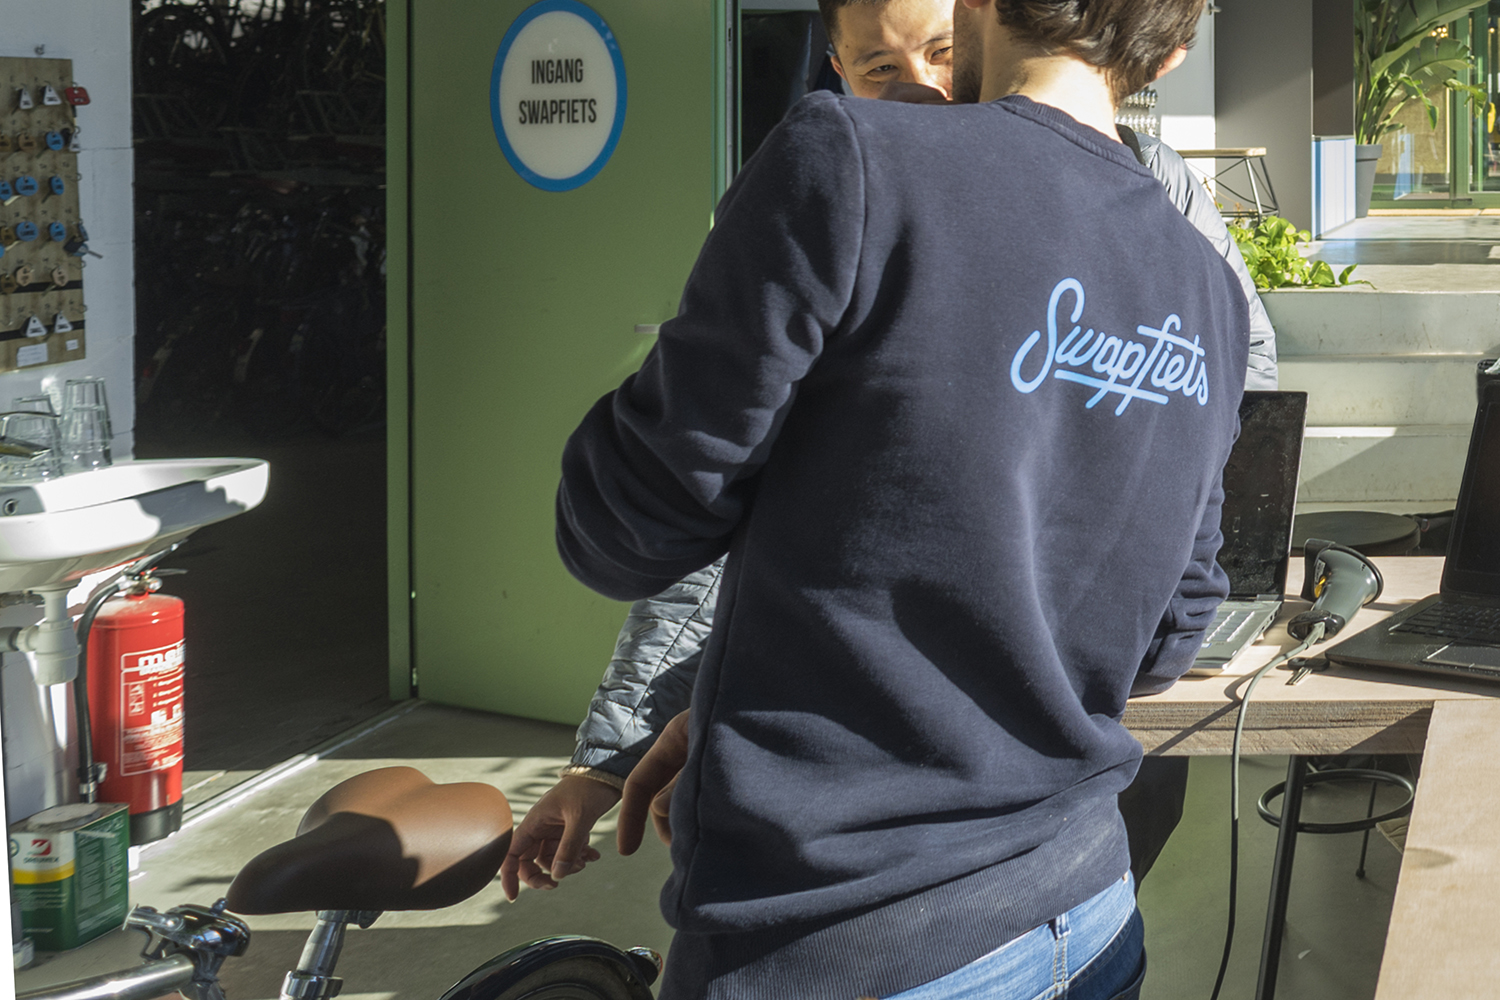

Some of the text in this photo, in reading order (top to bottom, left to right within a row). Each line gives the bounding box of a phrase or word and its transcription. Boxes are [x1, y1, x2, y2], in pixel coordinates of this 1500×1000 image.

[531, 58, 584, 85] INGANG
[518, 98, 598, 125] SWAPFIETS
[1010, 277, 1209, 417] Swapfiets
